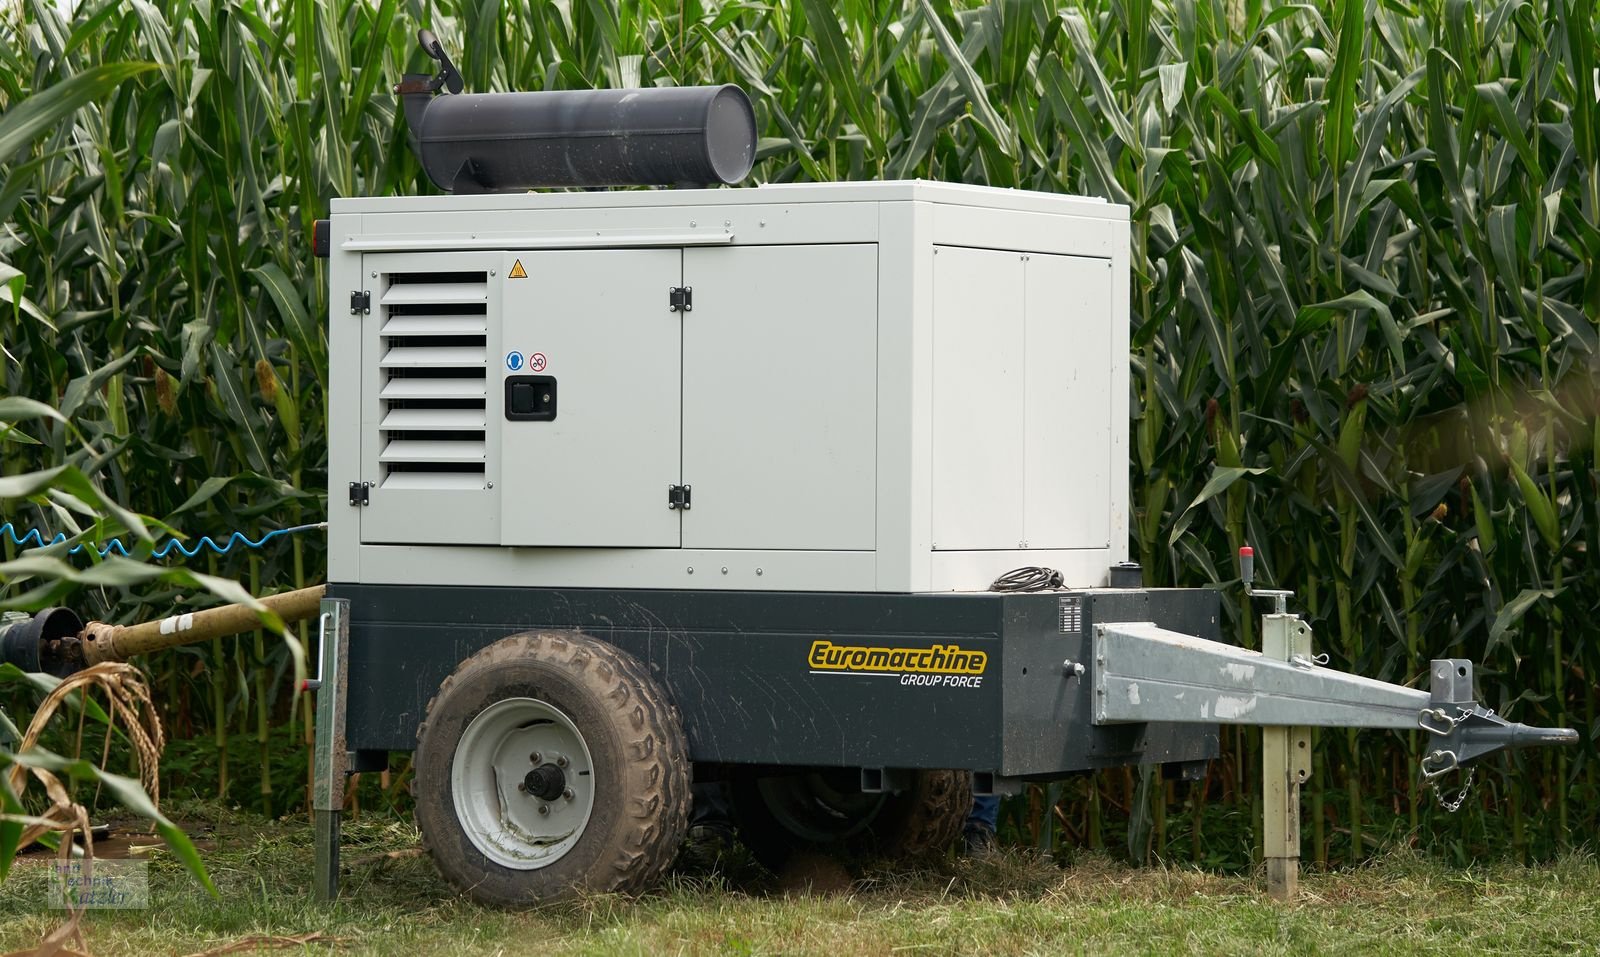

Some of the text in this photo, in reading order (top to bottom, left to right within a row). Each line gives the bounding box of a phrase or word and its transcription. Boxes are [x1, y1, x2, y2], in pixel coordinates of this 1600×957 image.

[809, 642, 986, 674] Euromacchine
[900, 674, 983, 688] GROUP FORCE
